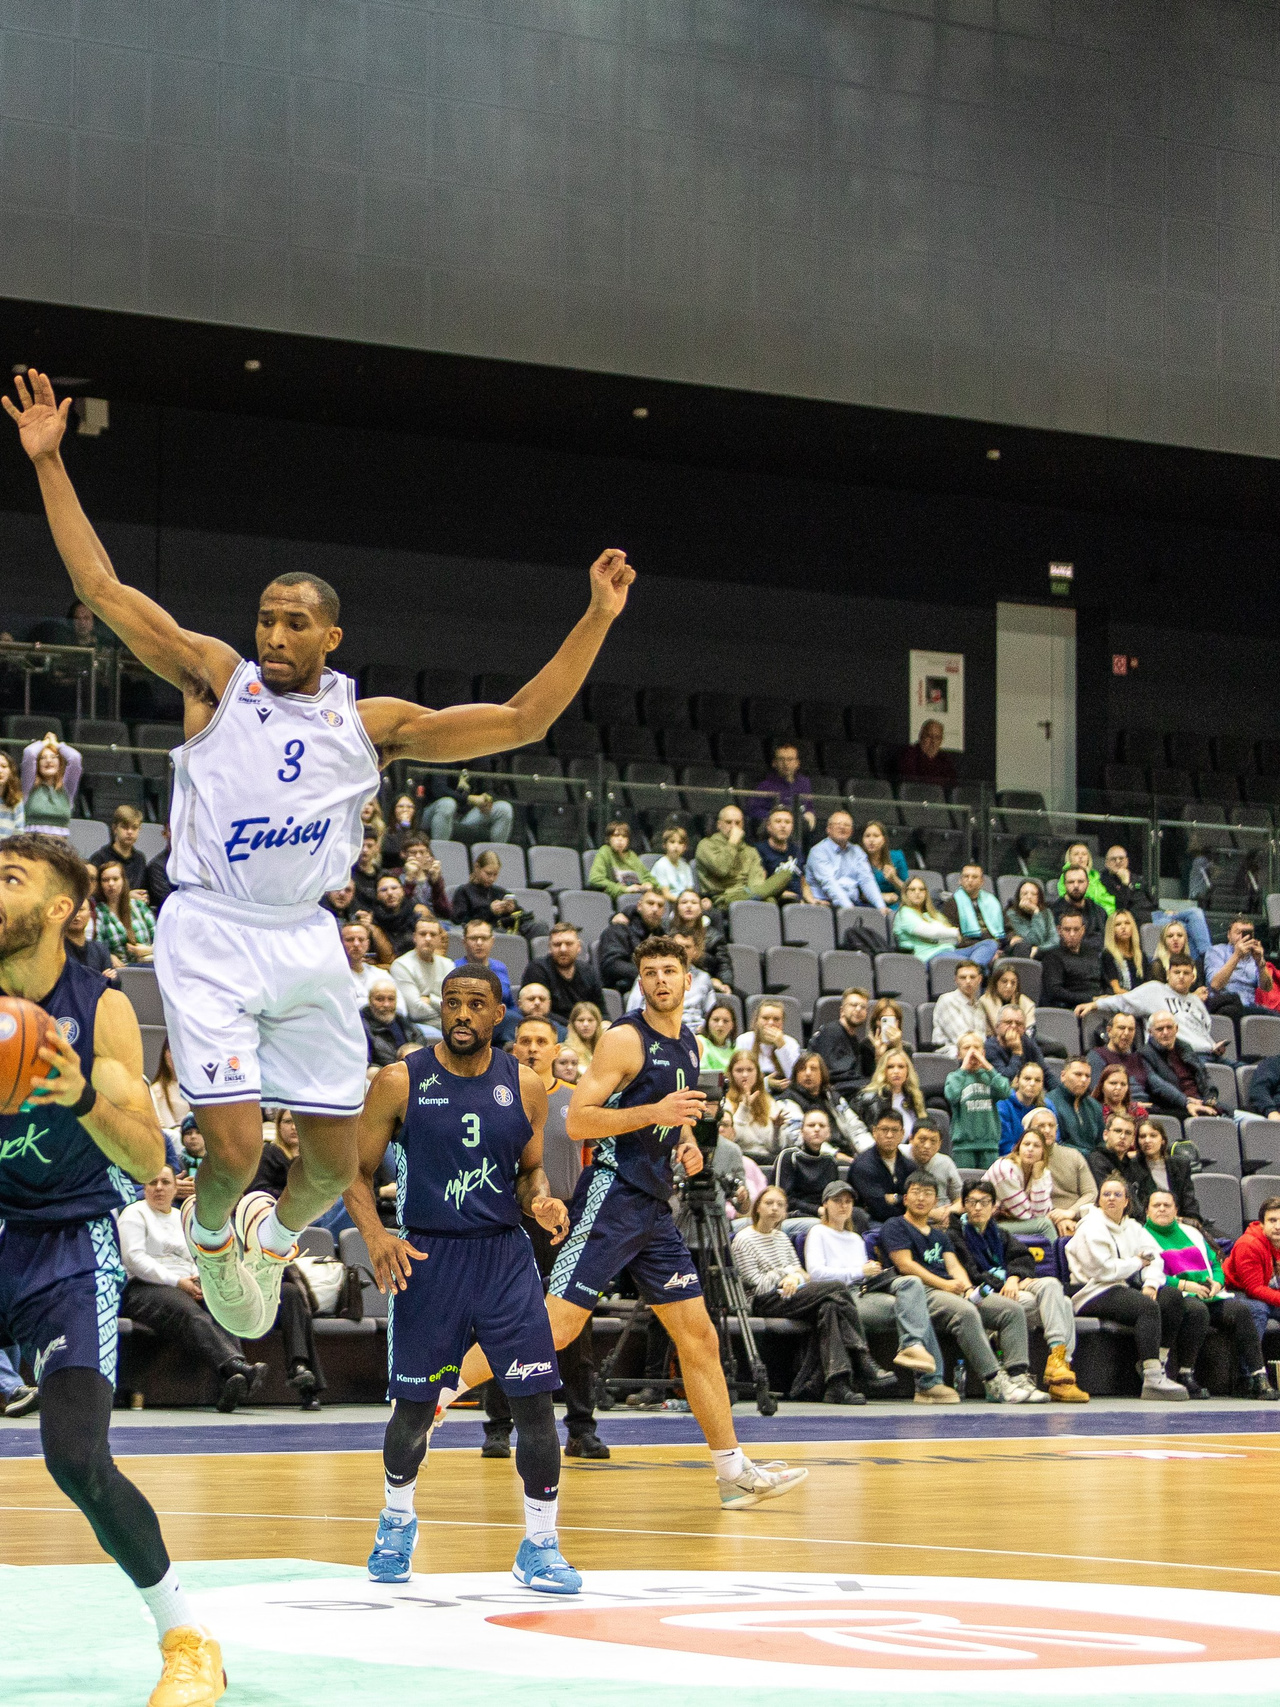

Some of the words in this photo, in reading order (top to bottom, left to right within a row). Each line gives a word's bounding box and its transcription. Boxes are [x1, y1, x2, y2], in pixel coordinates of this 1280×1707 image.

[277, 739, 305, 783] 3
[224, 816, 331, 863] Enisey
[419, 1097, 449, 1106] Kempa
[461, 1113, 480, 1147] 3
[396, 1373, 427, 1385] Kempa
